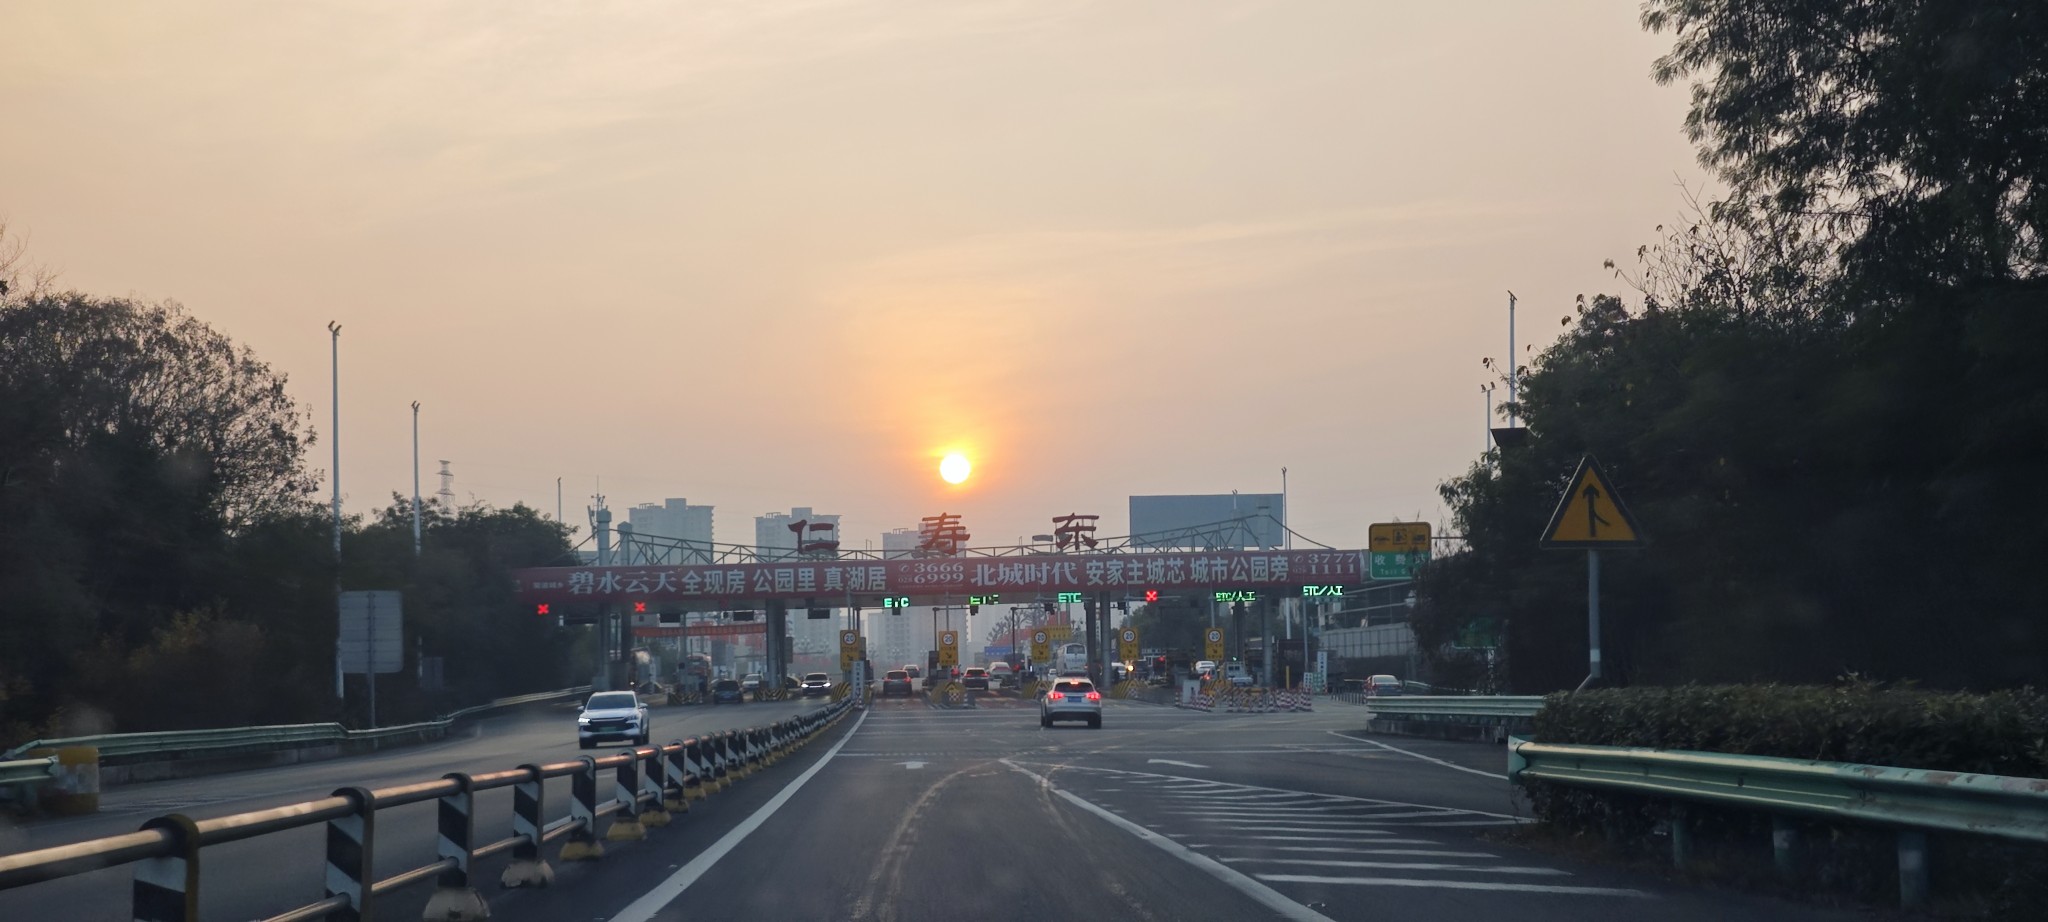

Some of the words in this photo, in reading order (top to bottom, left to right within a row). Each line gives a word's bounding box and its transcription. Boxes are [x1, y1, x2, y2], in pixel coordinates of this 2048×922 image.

[788, 513, 1099, 556] 仁寿东
[1308, 553, 1356, 564] 3777
[914, 562, 964, 573] 3666
[971, 561, 1078, 587] 北城时代
[1086, 557, 1185, 586] 安家主城芯
[1190, 555, 1289, 583] 城市公园旁
[1310, 564, 1355, 575] 1111
[568, 570, 677, 595] 碧水云天
[682, 569, 746, 595] 全现房
[753, 568, 816, 593] 公园里
[824, 566, 887, 592] 真湖居
[913, 573, 964, 584] 6999
[1215, 590, 1256, 602] ETC/人工
[1303, 585, 1343, 596] ETC/人工
[1058, 592, 1082, 603] ETC
[944, 635, 953, 643] 20
[1125, 632, 1134, 640] 20
